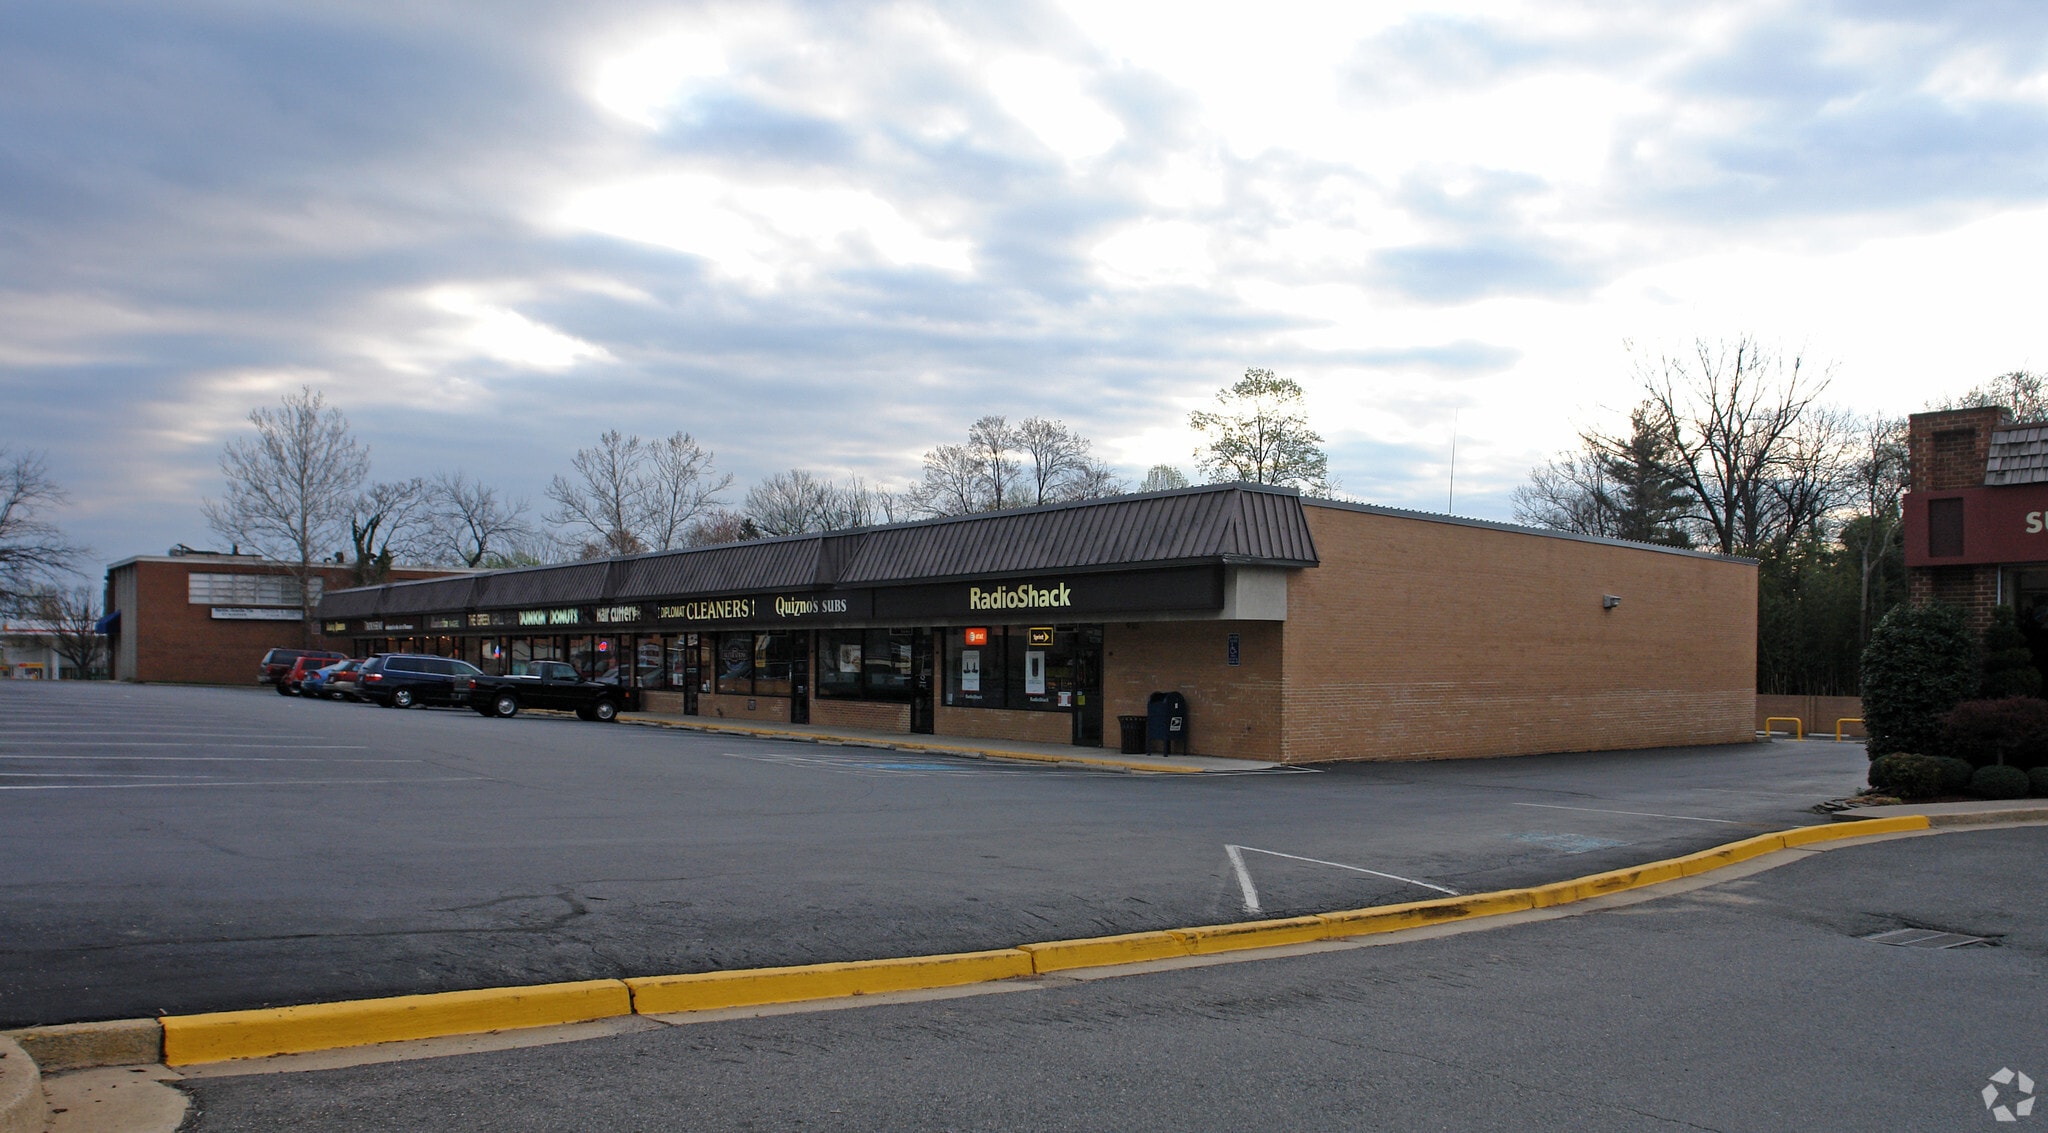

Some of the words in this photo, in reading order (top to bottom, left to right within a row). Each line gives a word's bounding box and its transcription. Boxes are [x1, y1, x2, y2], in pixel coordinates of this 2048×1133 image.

[2025, 511, 2048, 533] S
[776, 596, 819, 617] Quizno's
[970, 582, 1071, 610] RadioShack
[550, 609, 579, 625] DONUTS
[661, 605, 685, 618] DIPLOMAT
[686, 599, 749, 620] CLEANERS
